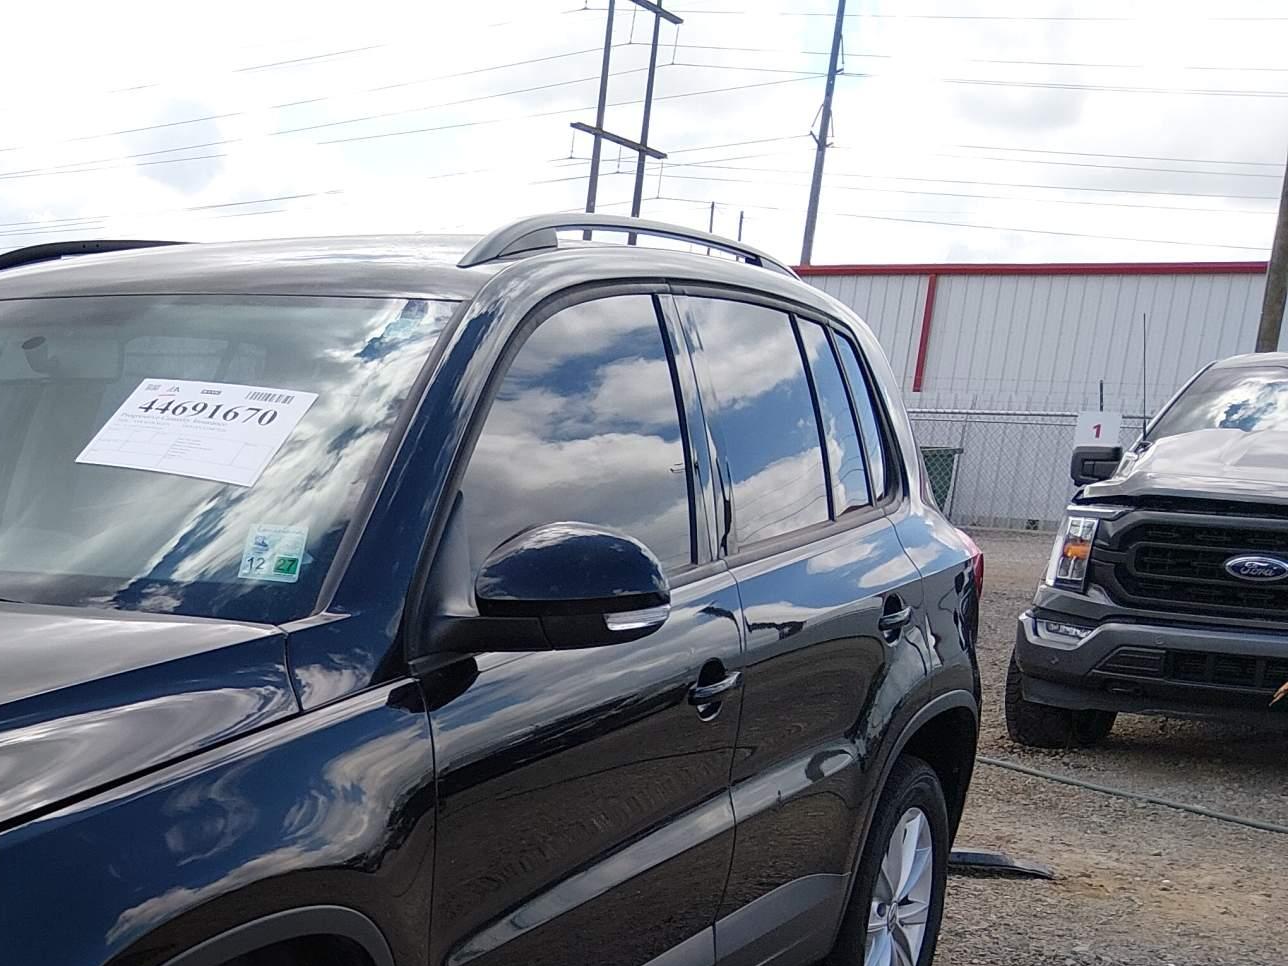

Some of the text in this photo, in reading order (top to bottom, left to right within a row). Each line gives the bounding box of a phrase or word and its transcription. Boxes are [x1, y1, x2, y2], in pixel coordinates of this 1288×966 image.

[138, 398, 278, 427] 44691670
[1092, 424, 1102, 438] 1
[1240, 561, 1278, 577] Ford
